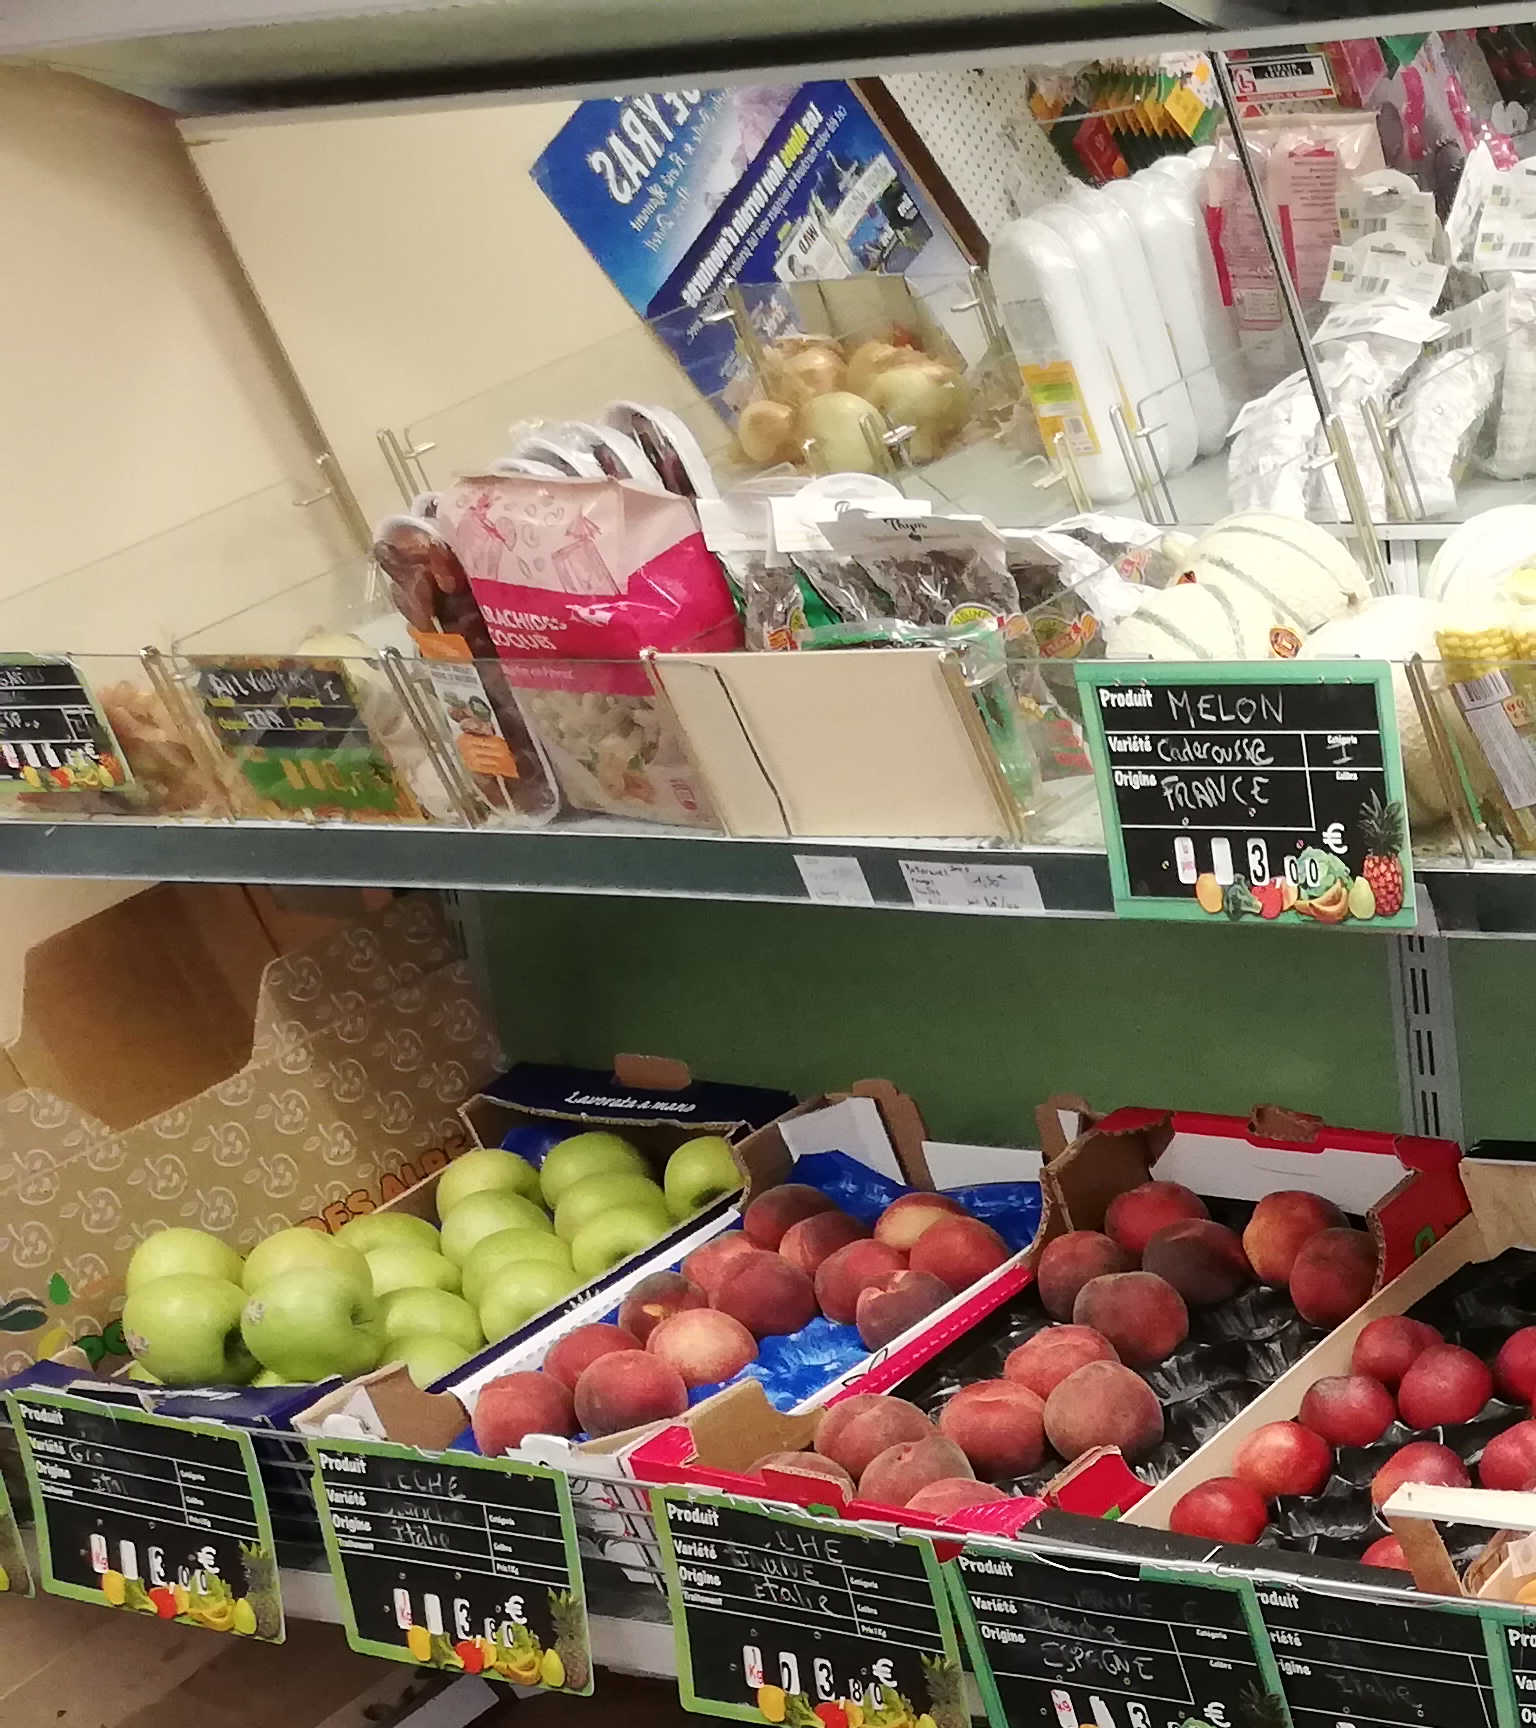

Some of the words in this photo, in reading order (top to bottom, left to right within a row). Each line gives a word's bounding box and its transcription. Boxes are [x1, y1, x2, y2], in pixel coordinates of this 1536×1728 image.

[1099, 689, 1153, 708] Produit
[1167, 689, 1284, 728] MELON
[1108, 736, 1152, 753] Variété
[1114, 770, 1157, 788] Origine
[1161, 775, 1270, 811] FRANCE
[1255, 1590, 1300, 1612] roduit
